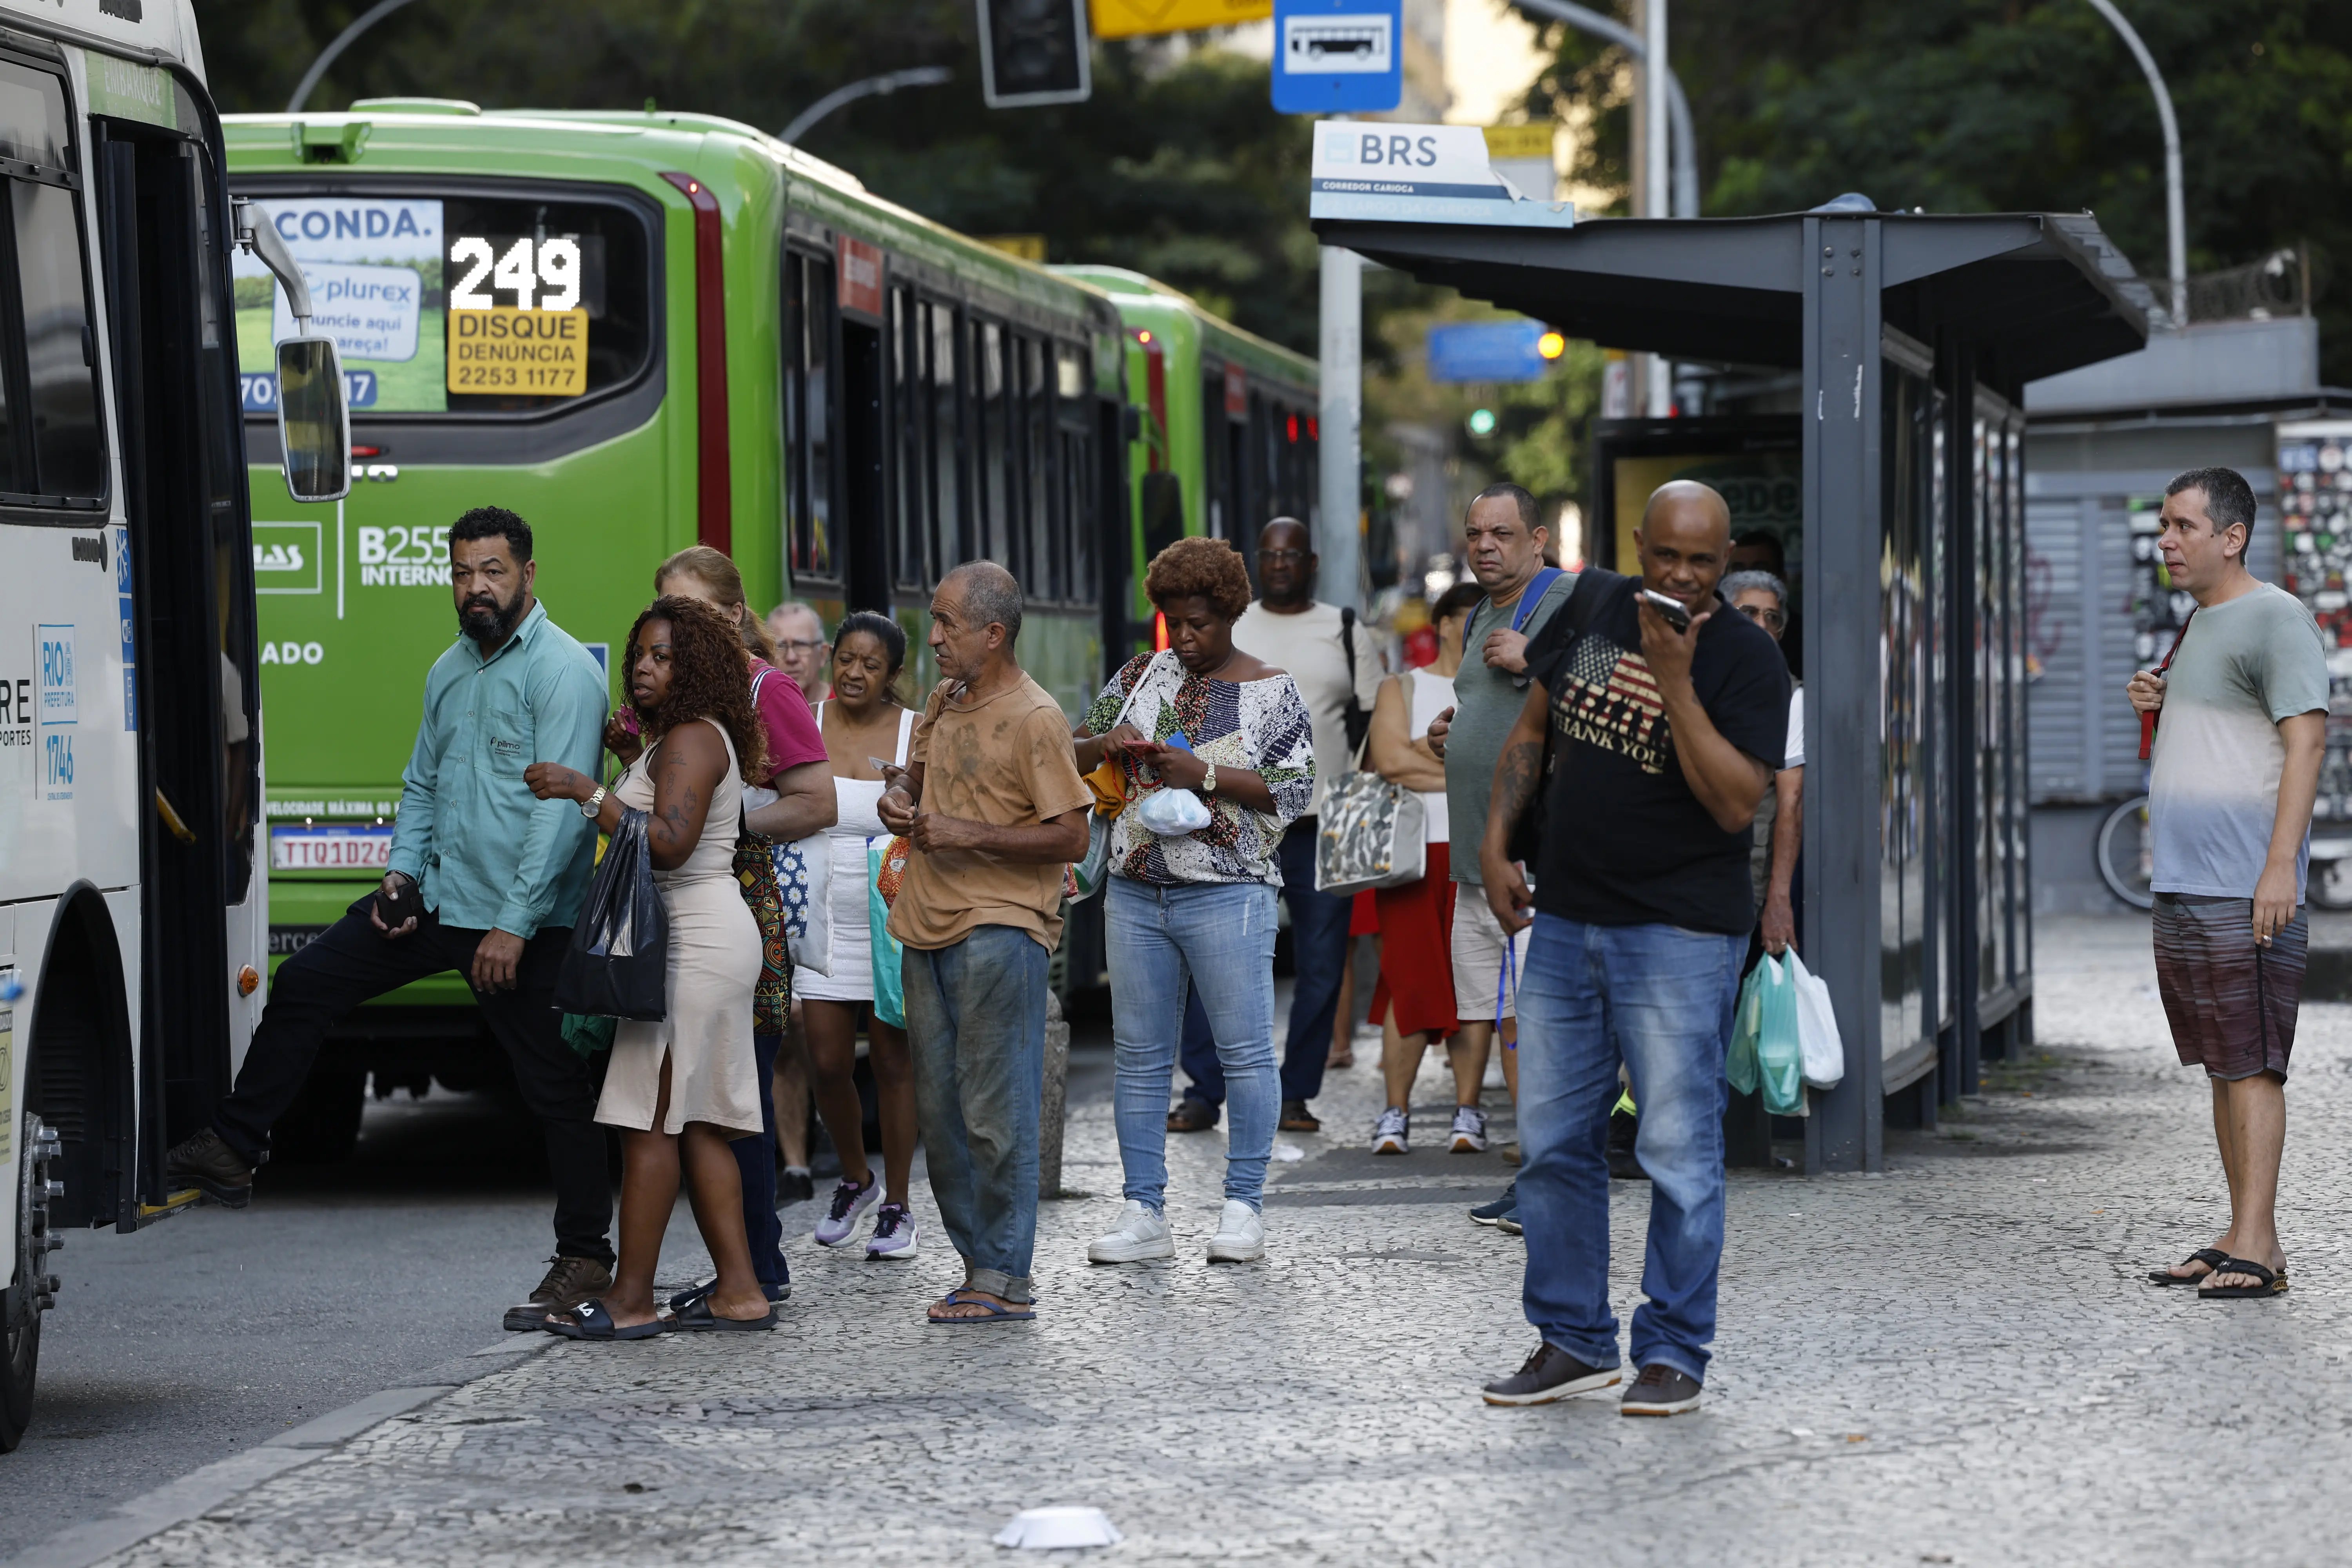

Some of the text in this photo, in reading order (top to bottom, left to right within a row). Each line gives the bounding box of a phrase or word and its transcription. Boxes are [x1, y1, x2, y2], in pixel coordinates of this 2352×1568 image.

[103, 56, 161, 107] EMBARQUE
[1361, 134, 1437, 167] BRS
[1322, 181, 1414, 194] CORREDOR CARIOCA
[451, 237, 581, 311] 249
[327, 277, 412, 302] plurex
[366, 316, 401, 332] aqui
[459, 315, 577, 340] DISQUE
[458, 339, 575, 363] DENÚNCIA
[458, 367, 576, 387] 2253 1177
[240, 376, 276, 405] 70
[43, 641, 64, 686] RIO
[260, 641, 324, 664] ADO
[0, 679, 31, 724] RE
[44, 691, 74, 707] PREFEITURA
[1552, 710, 1666, 767] THANK YOU
[47, 735, 73, 785] 1746
[267, 801, 325, 815] VELOCIDADE
[328, 797, 375, 815] MÁXIMA
